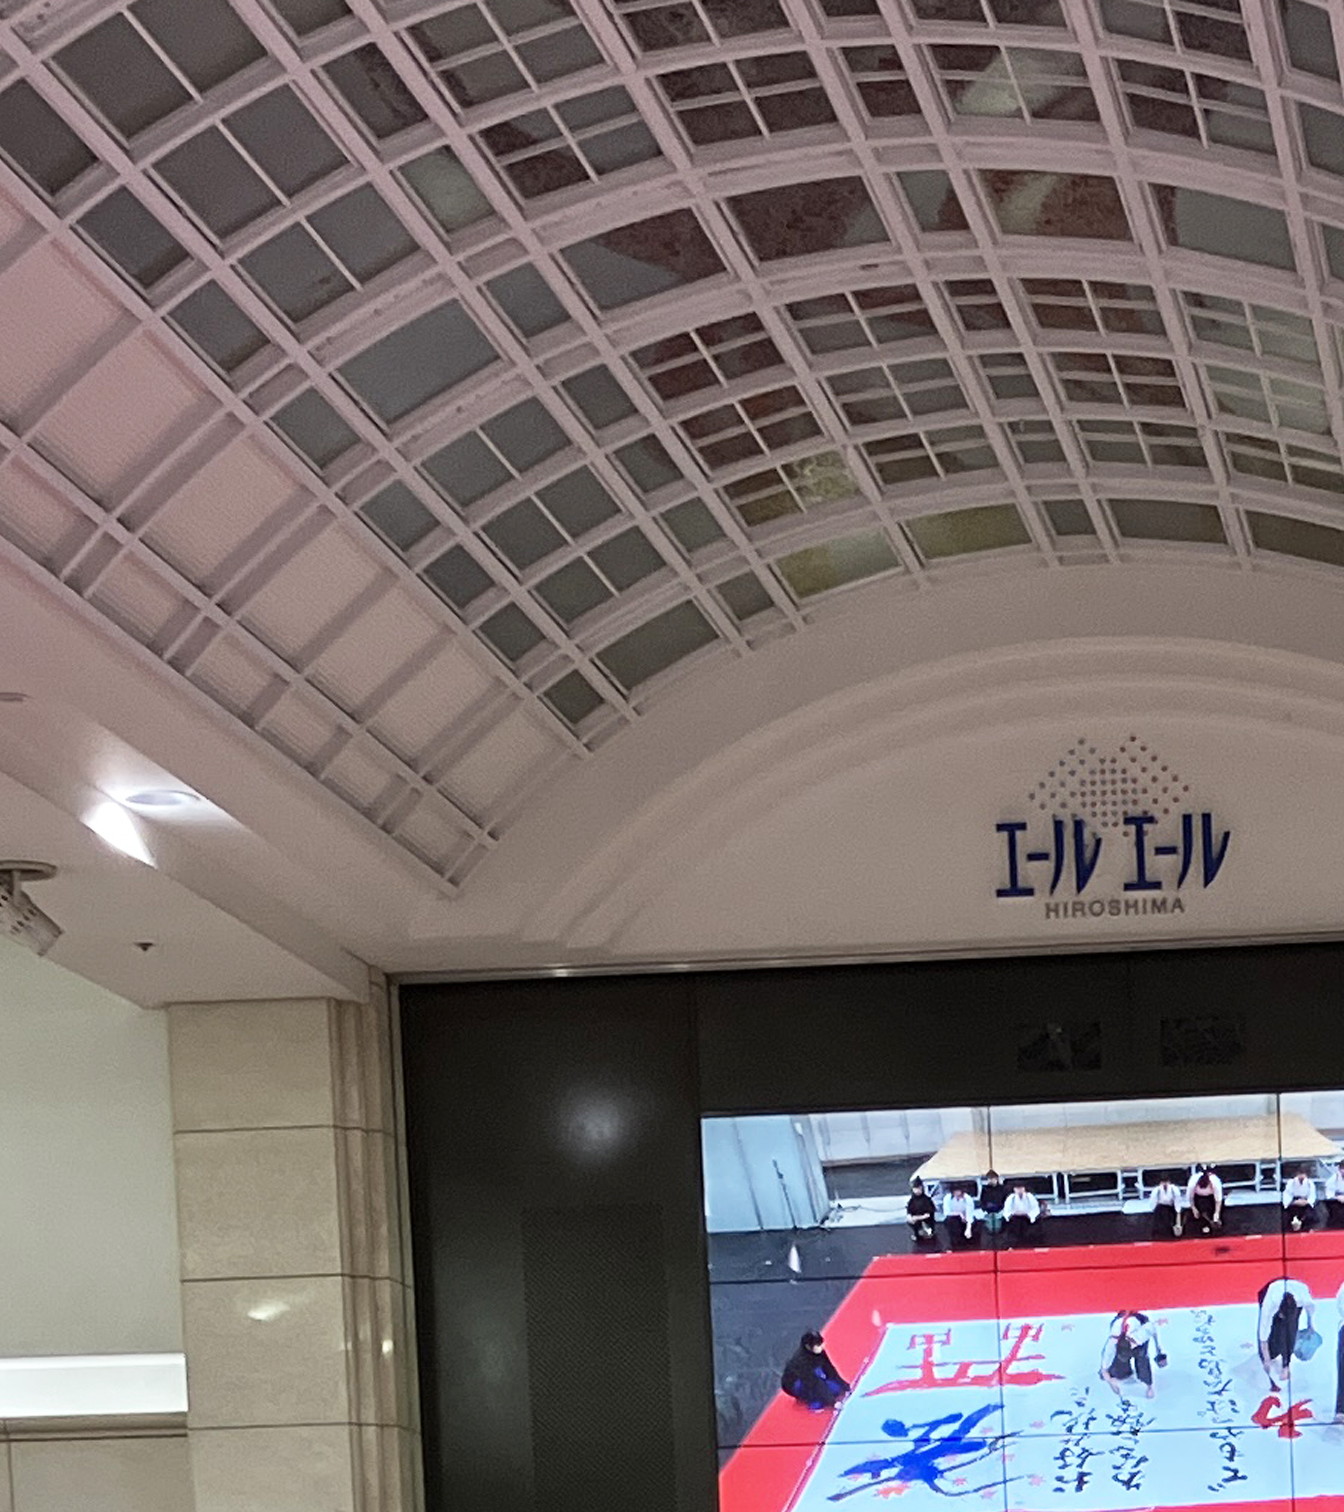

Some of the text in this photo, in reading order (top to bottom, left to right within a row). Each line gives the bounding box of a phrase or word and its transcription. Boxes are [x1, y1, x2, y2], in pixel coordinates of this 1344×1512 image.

[995, 812, 1231, 898] エール エール
[1044, 897, 1186, 919] HIROSHIMA
